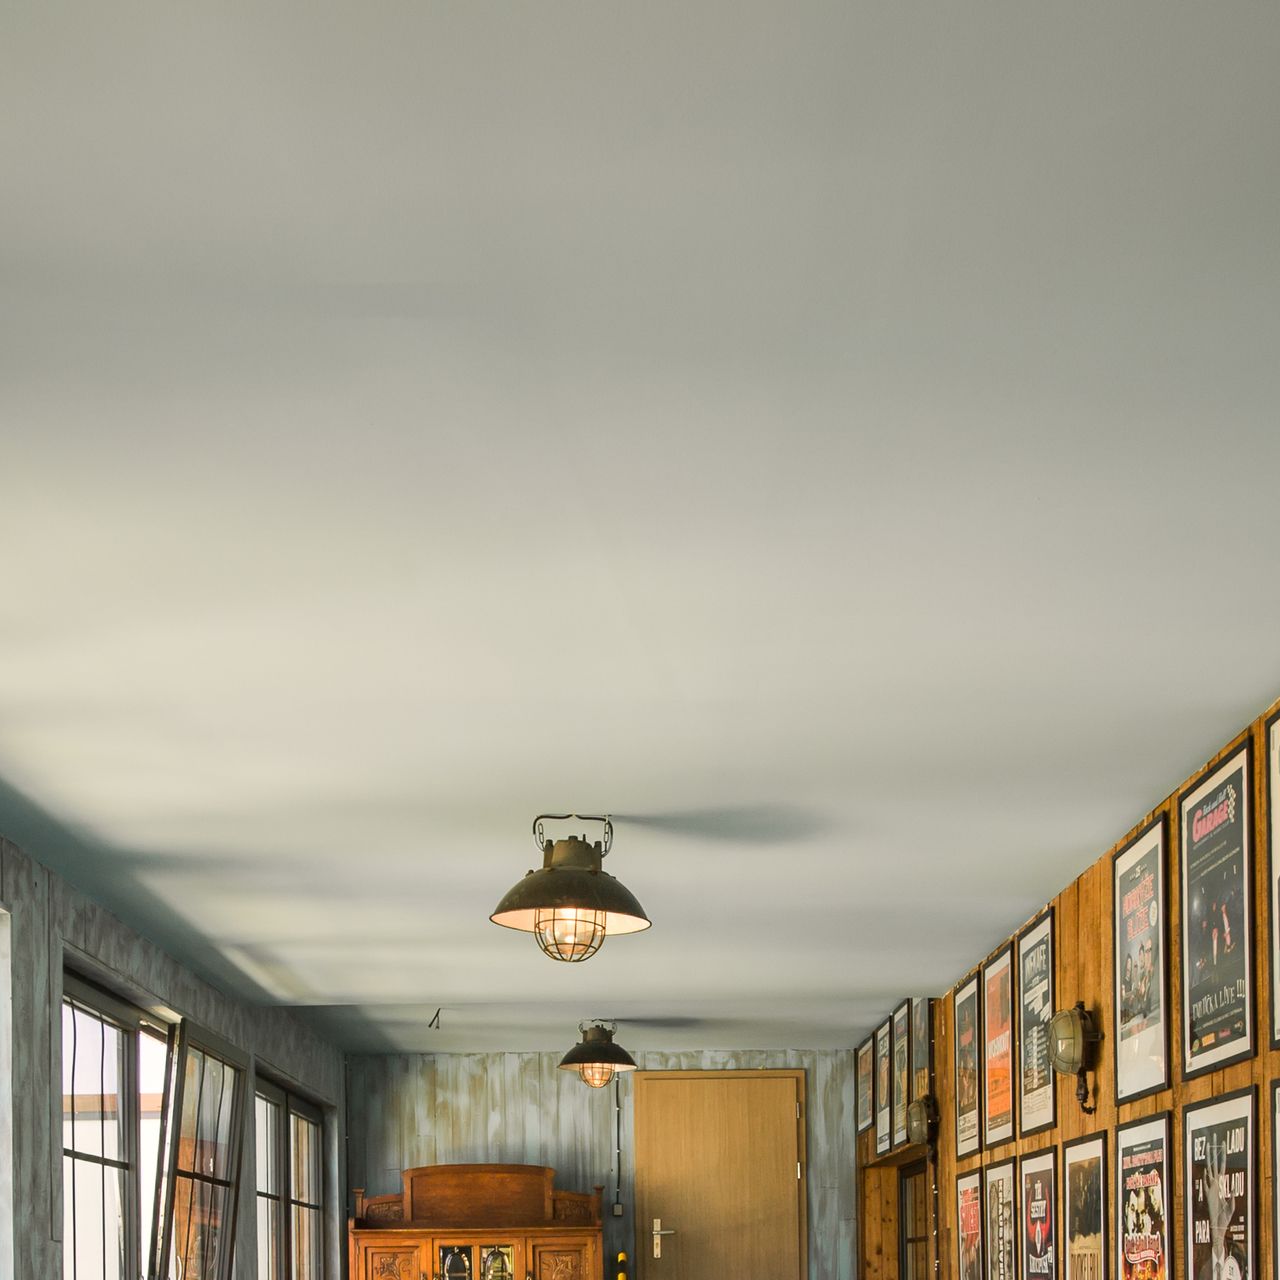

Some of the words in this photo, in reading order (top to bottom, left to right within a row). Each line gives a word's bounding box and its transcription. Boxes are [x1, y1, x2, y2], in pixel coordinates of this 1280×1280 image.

[1193, 799, 1228, 843] GARAGE
[1195, 1136, 1206, 1161] BEZ
[1227, 1127, 1244, 1154] LADU
[1219, 1172, 1244, 1199] SKLADU
[1195, 1220, 1210, 1243] PARA
